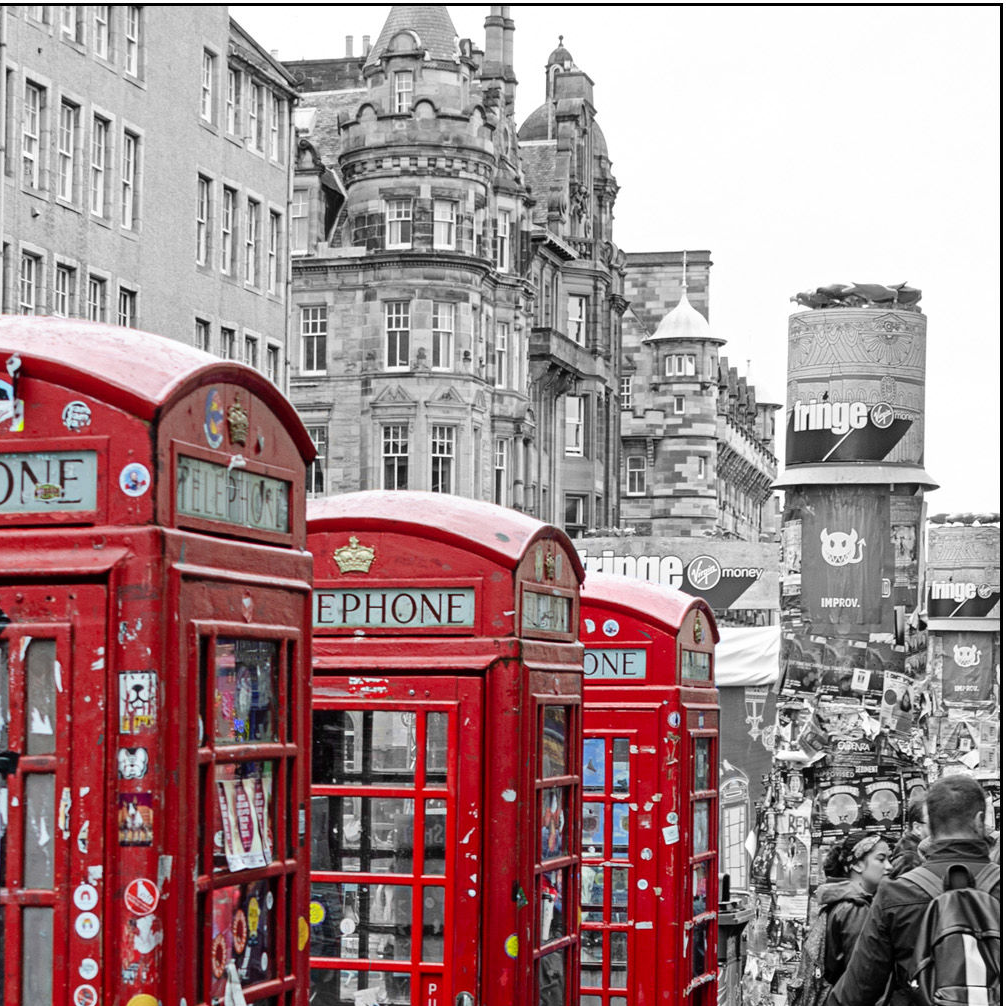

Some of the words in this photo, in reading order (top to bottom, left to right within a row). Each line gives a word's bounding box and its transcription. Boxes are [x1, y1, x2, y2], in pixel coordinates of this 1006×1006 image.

[794, 399, 868, 434] fringe
[722, 567, 763, 580] money
[317, 593, 465, 624] EPHONE
[821, 597, 860, 608] IMPROV.
